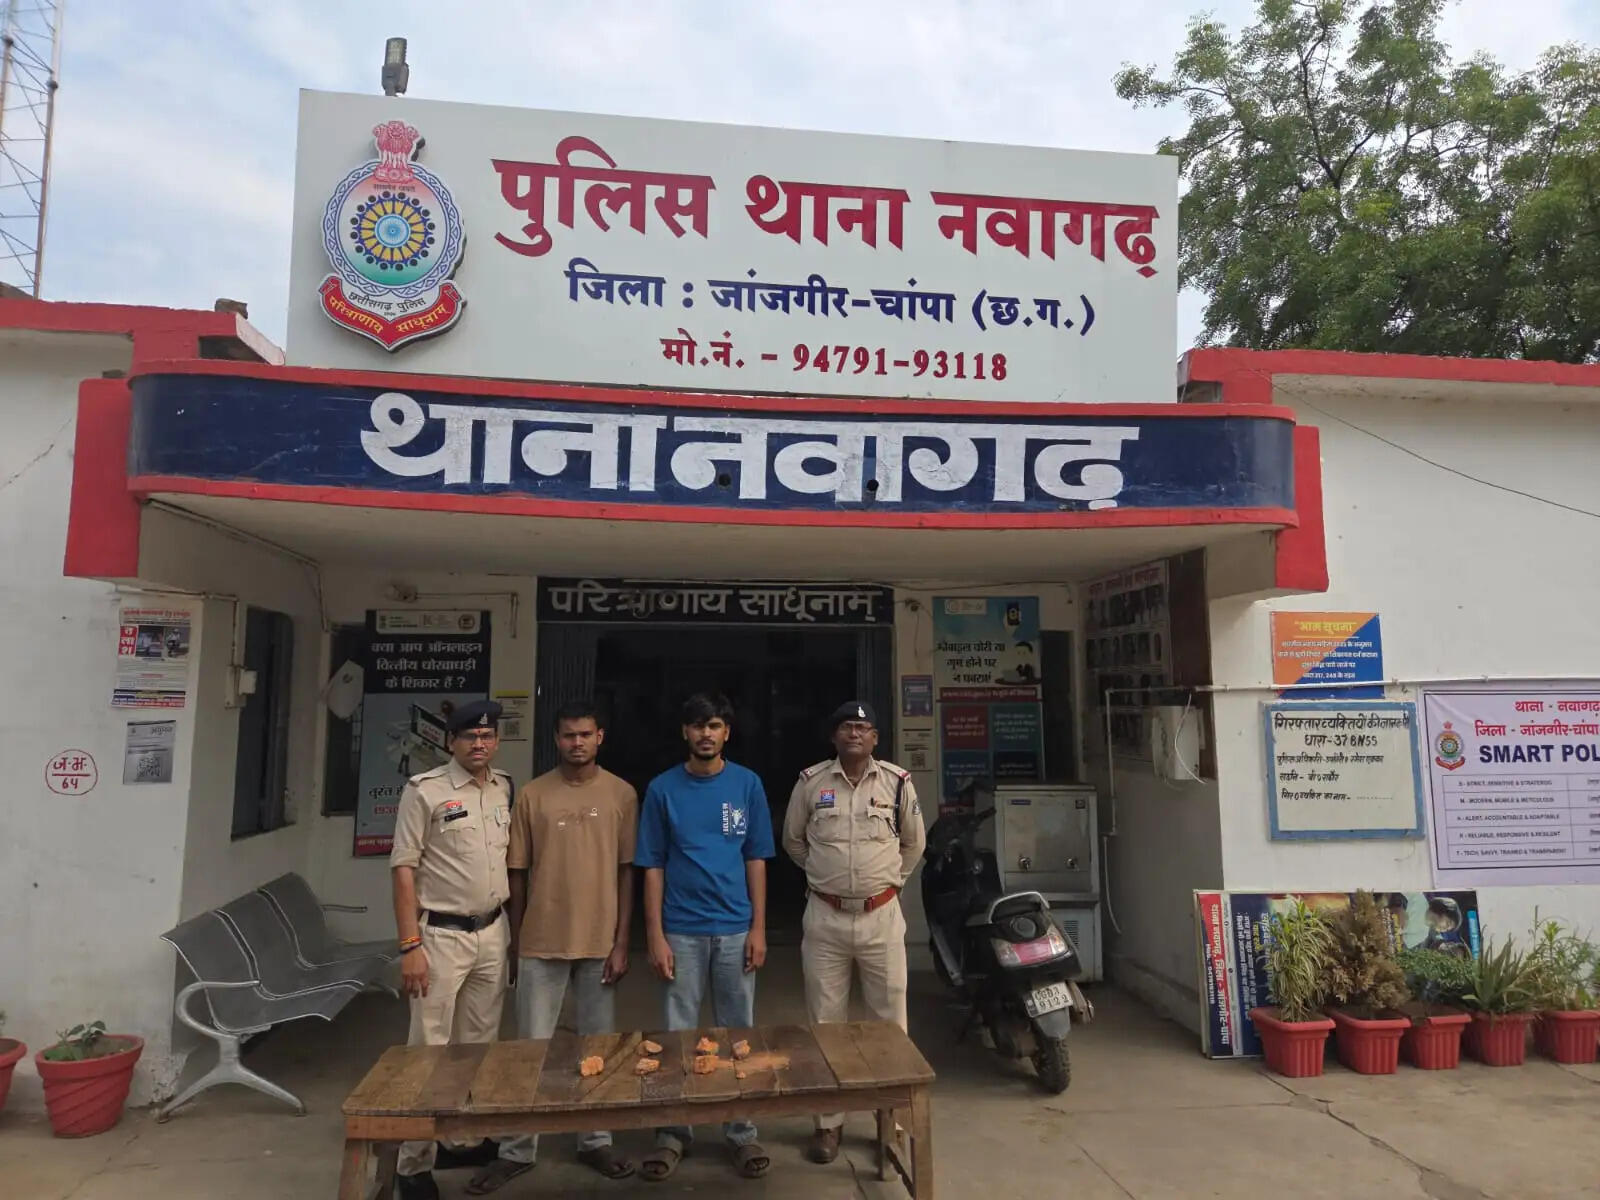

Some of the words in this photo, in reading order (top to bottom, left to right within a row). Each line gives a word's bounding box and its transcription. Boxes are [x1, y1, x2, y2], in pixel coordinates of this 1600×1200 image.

[491, 135, 716, 257] पुलिस
[745, 174, 911, 252] थाना
[930, 191, 1161, 278] नवागढ़
[396, 297, 427, 313] पुलिस
[563, 257, 666, 307] जिला
[708, 268, 956, 324] जांजगीर-चांपा
[971, 288, 1096, 337] (छ.ग.)
[659, 327, 744, 369] मो.नं.
[792, 343, 1008, 381] 94791-93118
[360, 392, 668, 492] थाना
[670, 414, 1140, 510] नवागढ़
[548, 579, 733, 618] परित्राणाय
[738, 586, 883, 622] साधूनाम्
[1515, 701, 1544, 712] थाना
[1474, 720, 1506, 736] जिला
[1520, 719, 1599, 737] जांजगीर-चांपा
[1479, 744, 1555, 763] SMART
[62, 777, 79, 789] 64
